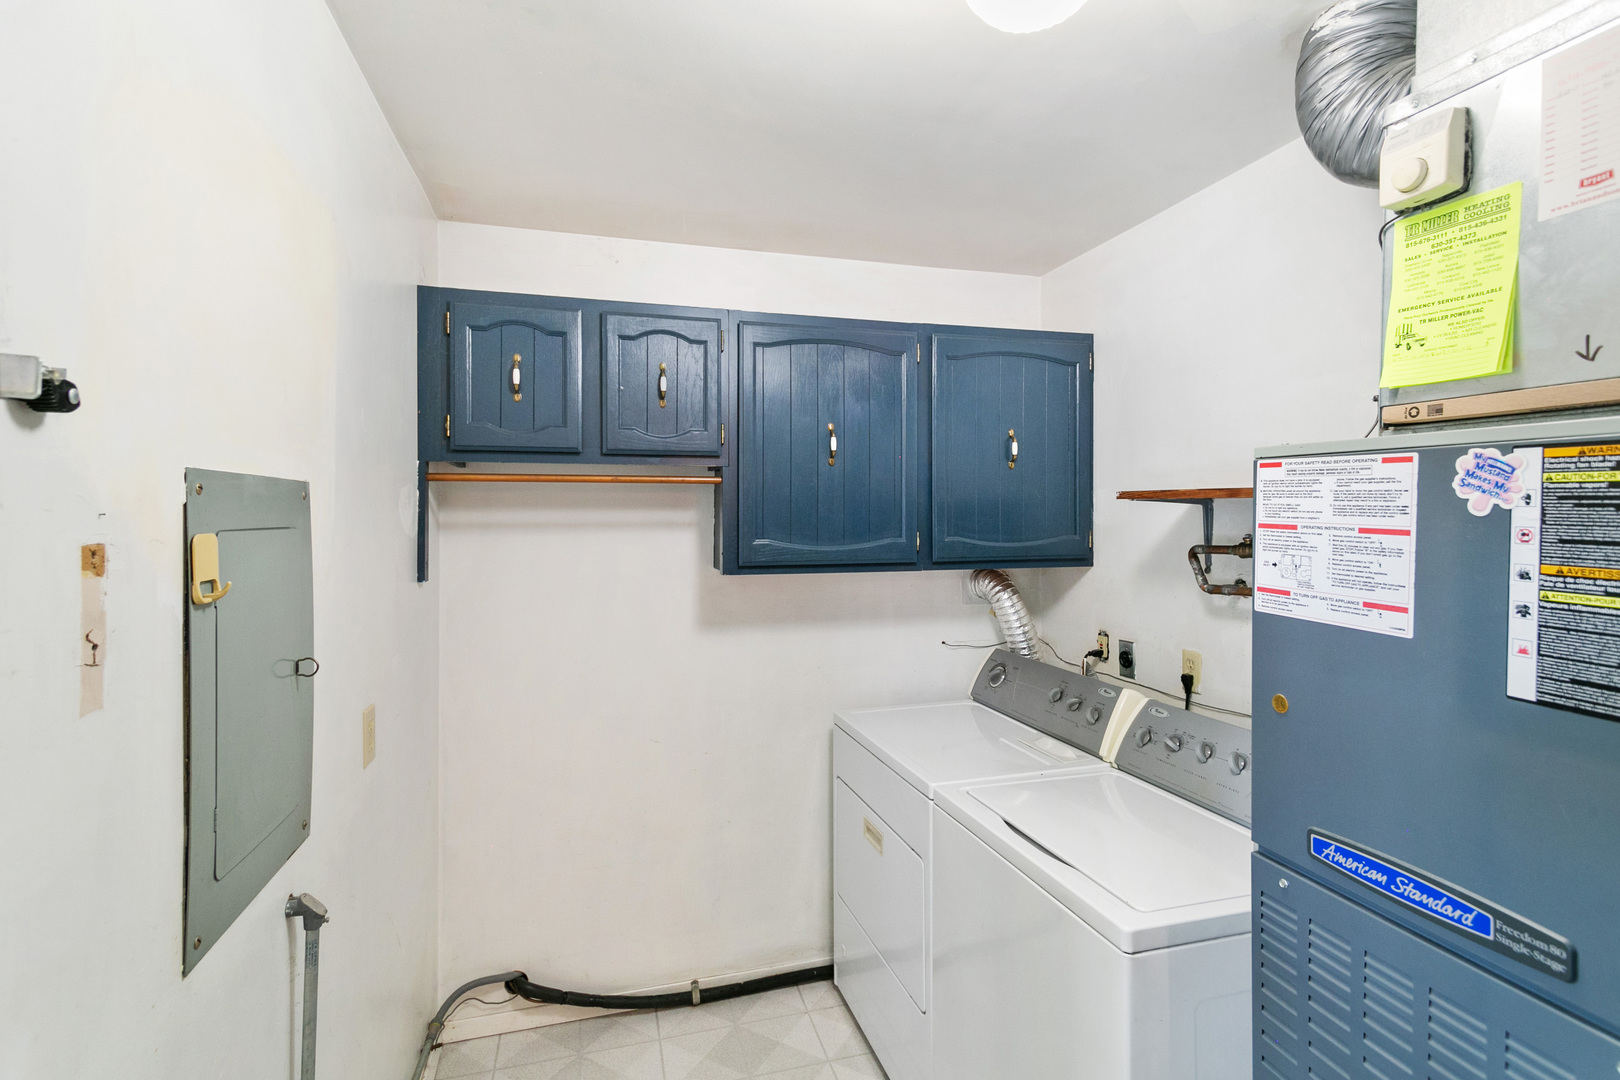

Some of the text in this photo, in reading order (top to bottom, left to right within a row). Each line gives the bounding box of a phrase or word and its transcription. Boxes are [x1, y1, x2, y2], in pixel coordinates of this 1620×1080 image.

[1583, 171, 1611, 187] bryant
[1463, 201, 1511, 220] COOLING
[1464, 193, 1511, 212] HEATING
[1405, 209, 1460, 238] TR MILLER
[1405, 214, 1507, 249] 815-676-3111 815-436-4331
[1404, 230, 1507, 262] SALES SERVICE INSTALLATION
[1430, 232, 1477, 249] 630-357-4373
[1398, 301, 1435, 313] EMERGENCY
[1437, 294, 1465, 306] SERVICE
[1466, 286, 1503, 299] AVAILABLE
[1428, 314, 1449, 324] MILLER
[1450, 307, 1484, 319] POWER-VAC
[1474, 452, 1487, 462] My
[1465, 470, 1509, 493] Makes My
[1475, 462, 1511, 482] Mustard
[1335, 598, 1360, 606] APPLIANCE
[1321, 844, 1477, 928] American Standard
[1495, 919, 1568, 960] Freedom 80
